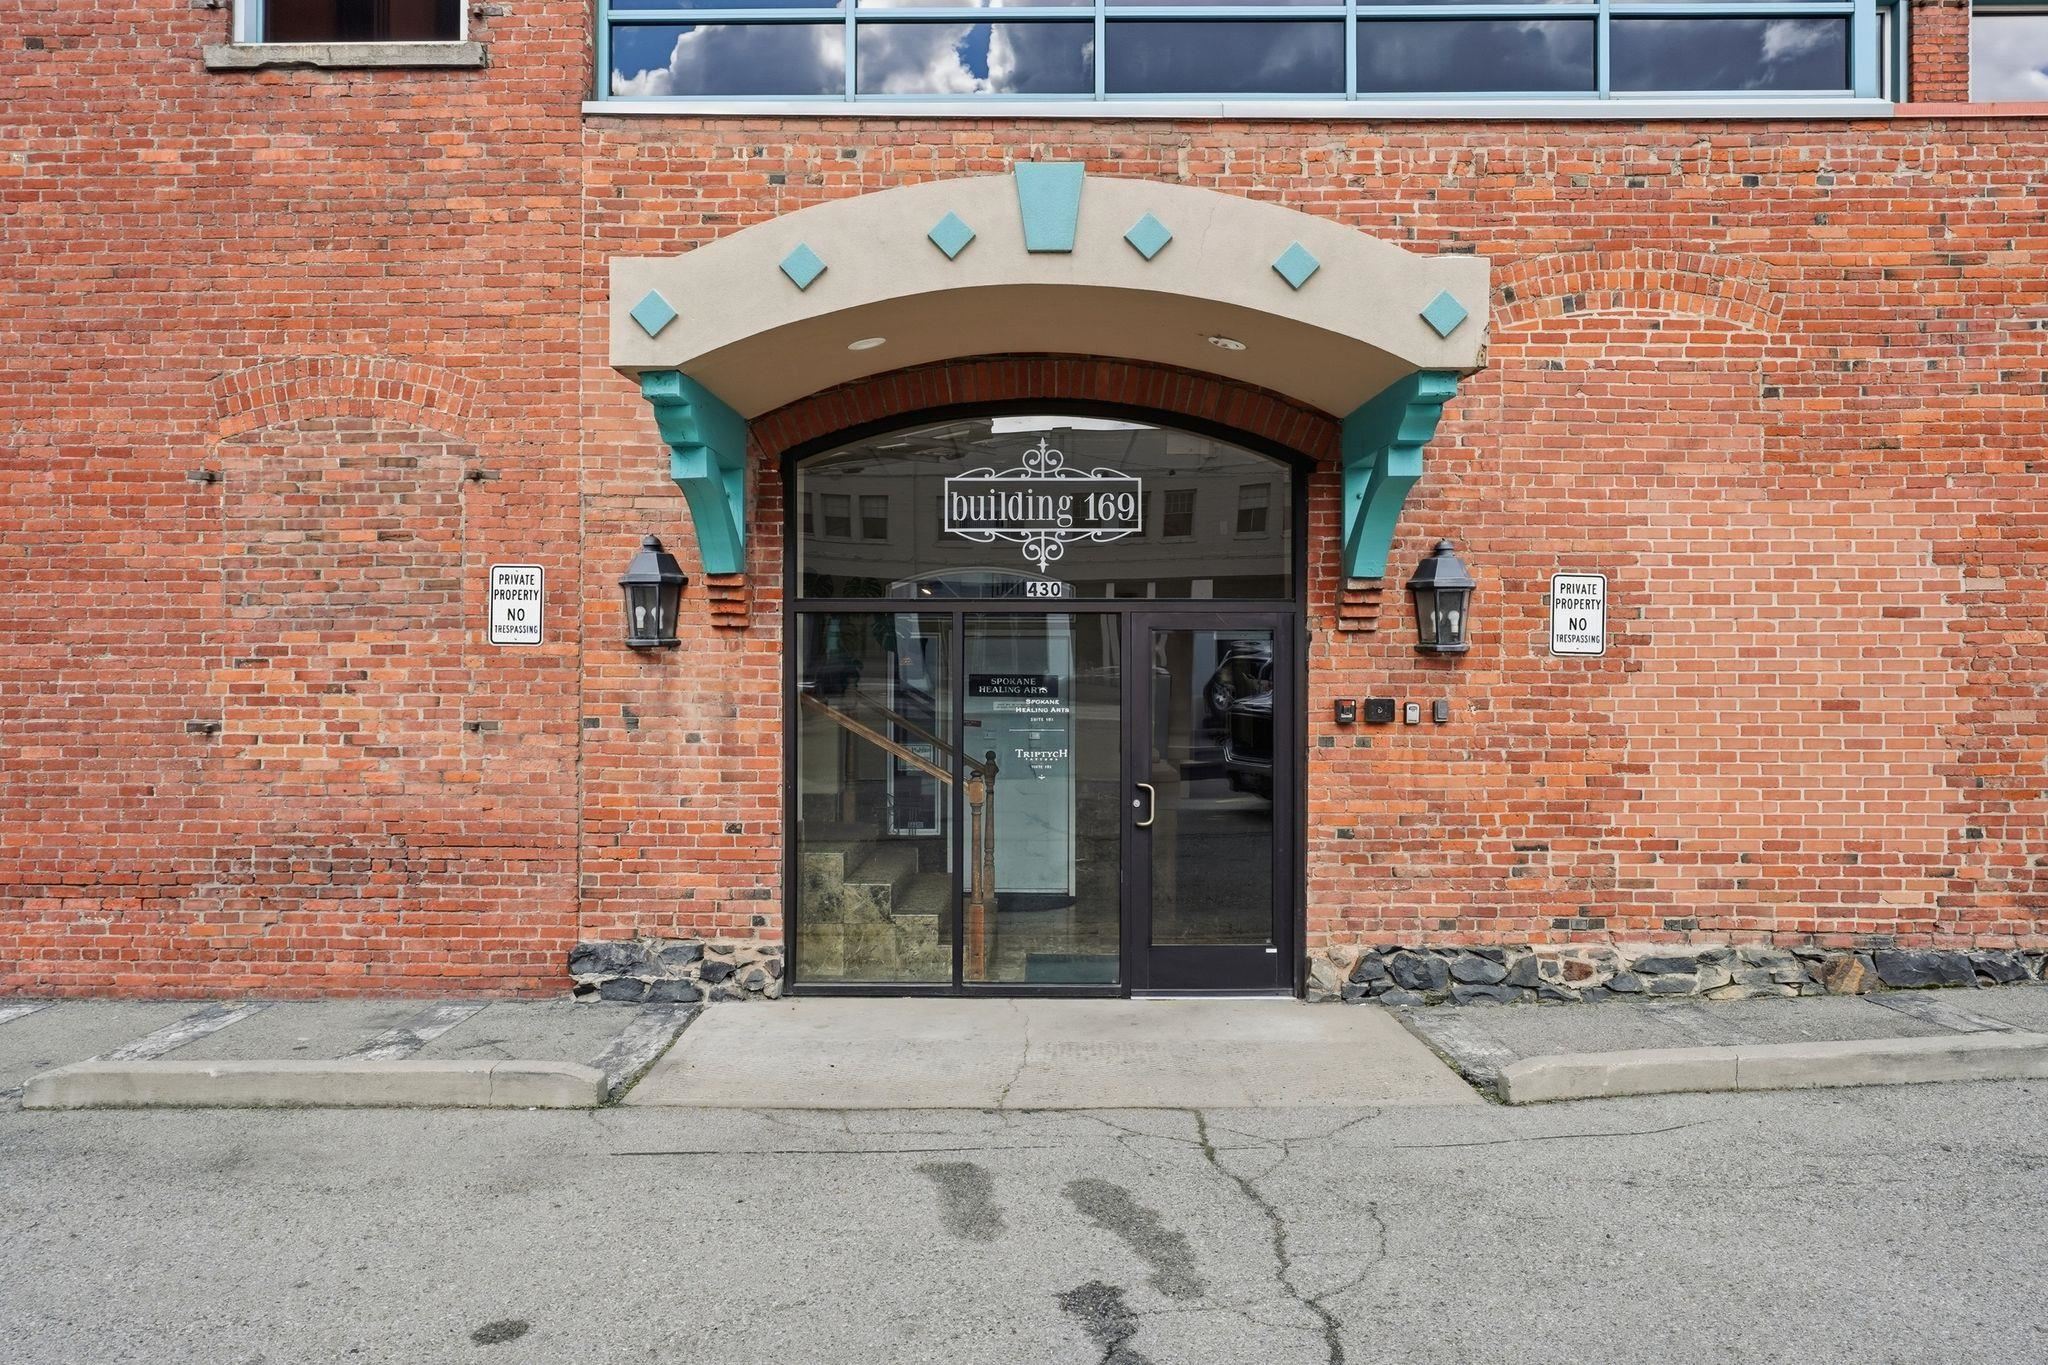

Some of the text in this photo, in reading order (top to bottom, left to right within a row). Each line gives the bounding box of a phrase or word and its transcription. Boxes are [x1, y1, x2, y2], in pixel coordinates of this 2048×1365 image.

[950, 488, 1135, 528] building 169
[498, 573, 535, 586] PRIVATE
[493, 588, 540, 601] PROPERTY
[1027, 582, 1061, 597] 430
[1560, 582, 1598, 595] PRIVATE
[1555, 597, 1602, 610] PROPERTY
[507, 607, 526, 622] NO
[494, 624, 539, 634] TRESPASSING
[1569, 617, 1588, 632] NO
[1556, 633, 1601, 644] TRESPASSING
[990, 677, 1036, 686] SPOKANE
[978, 685, 1020, 694] HEALING
[1014, 748, 1068, 758] TRIPTYCH
